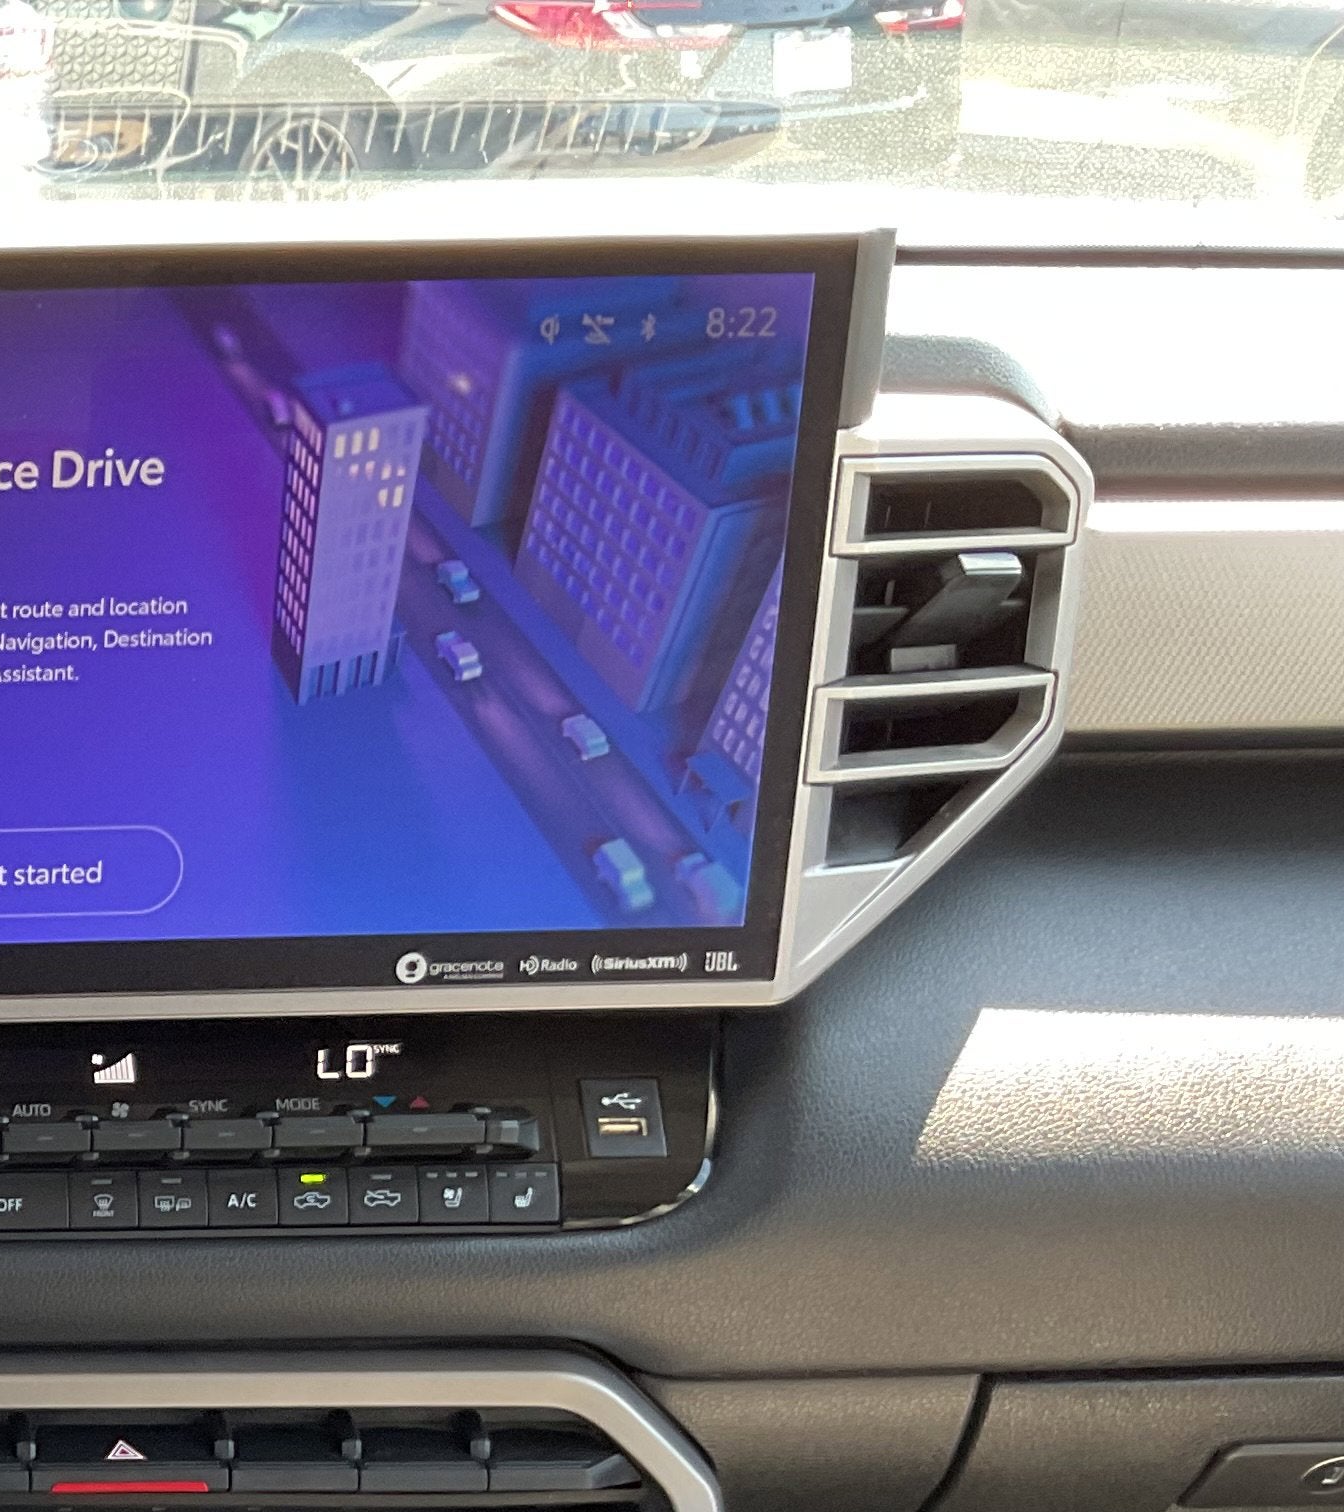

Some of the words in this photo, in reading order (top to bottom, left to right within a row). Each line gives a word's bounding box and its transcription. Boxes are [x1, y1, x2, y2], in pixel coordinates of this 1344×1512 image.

[706, 306, 777, 339] 8:22
[51, 447, 165, 490] Drive
[12, 602, 64, 620] route
[68, 598, 104, 618] and
[109, 597, 188, 617] location
[103, 629, 213, 650] Destination
[14, 860, 103, 885] started
[429, 959, 504, 976] gracenote
[541, 958, 577, 972] Radio
[704, 951, 738, 972] JBL
[373, 1044, 400, 1054] SYNC
[12, 1103, 51, 1118] AUTO
[189, 1100, 229, 1113] SYNC
[275, 1098, 320, 1112] MODE
[227, 1192, 257, 1208] A/C
